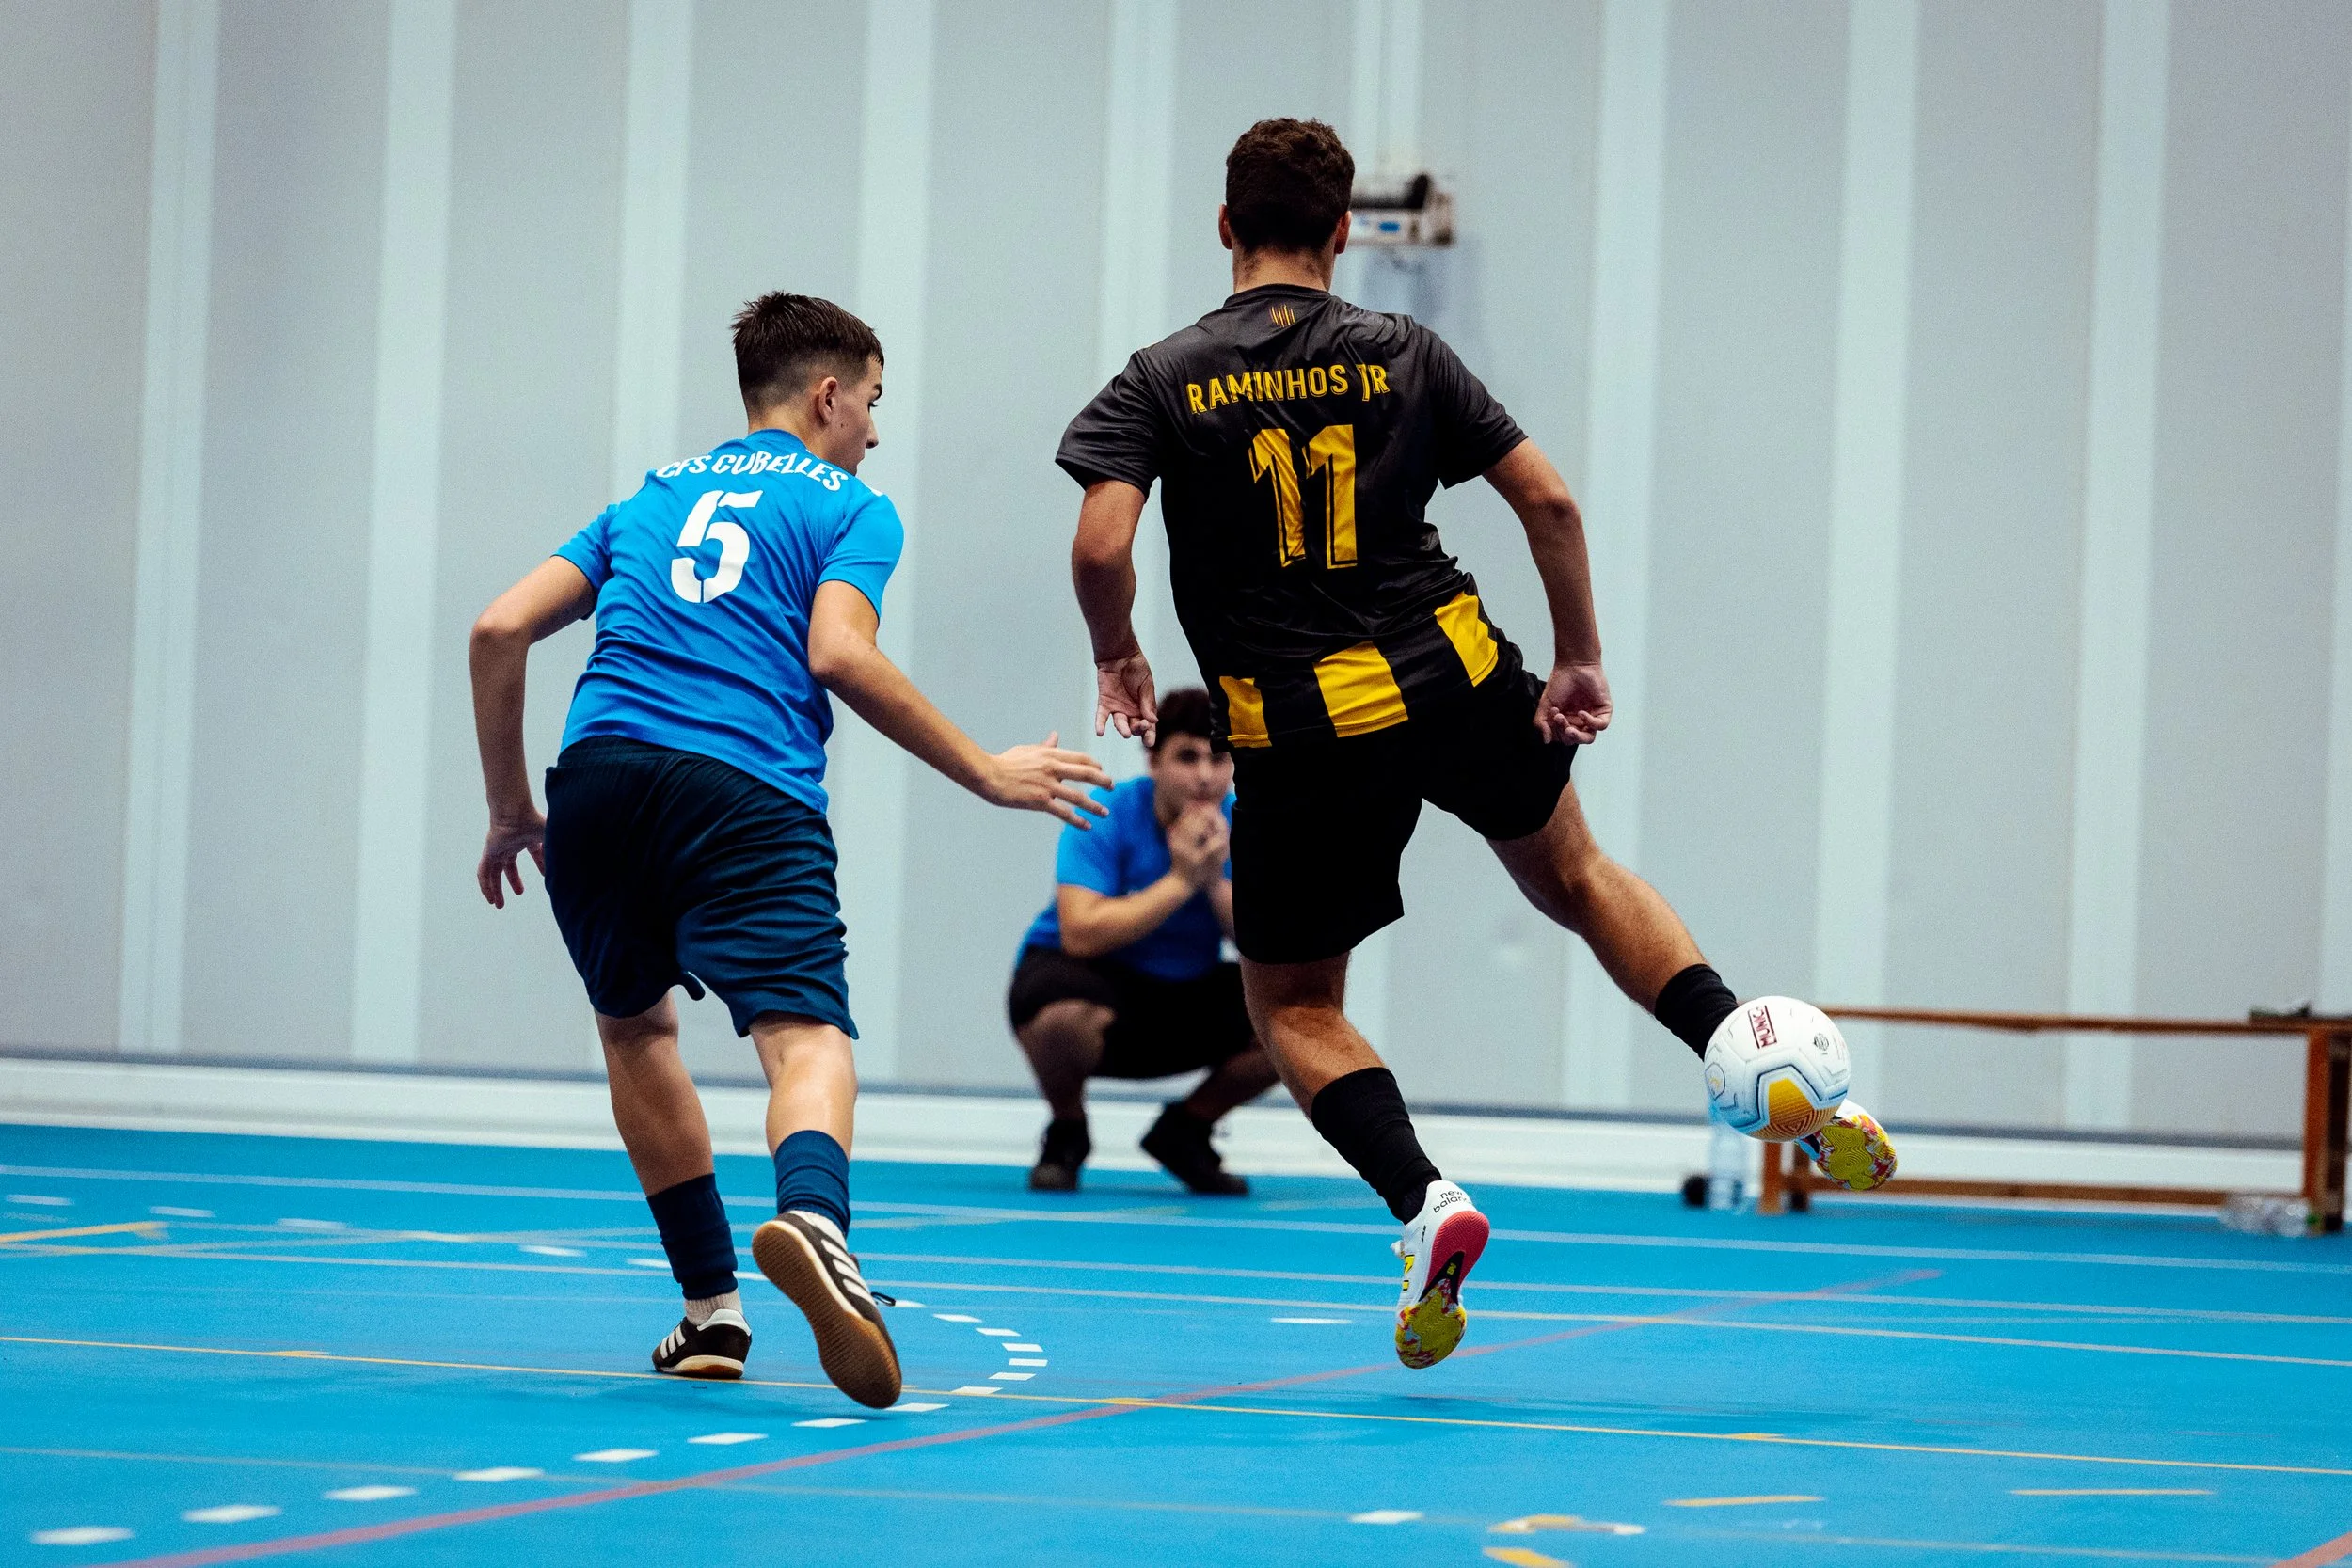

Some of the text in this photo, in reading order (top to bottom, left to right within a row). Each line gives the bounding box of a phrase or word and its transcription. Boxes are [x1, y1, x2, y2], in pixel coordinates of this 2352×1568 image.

[1186, 363, 1391, 414] RAMINHOS JR
[656, 451, 849, 491] CFS CUBELLES
[1248, 424, 1358, 569] 11
[671, 490, 763, 604] 5
